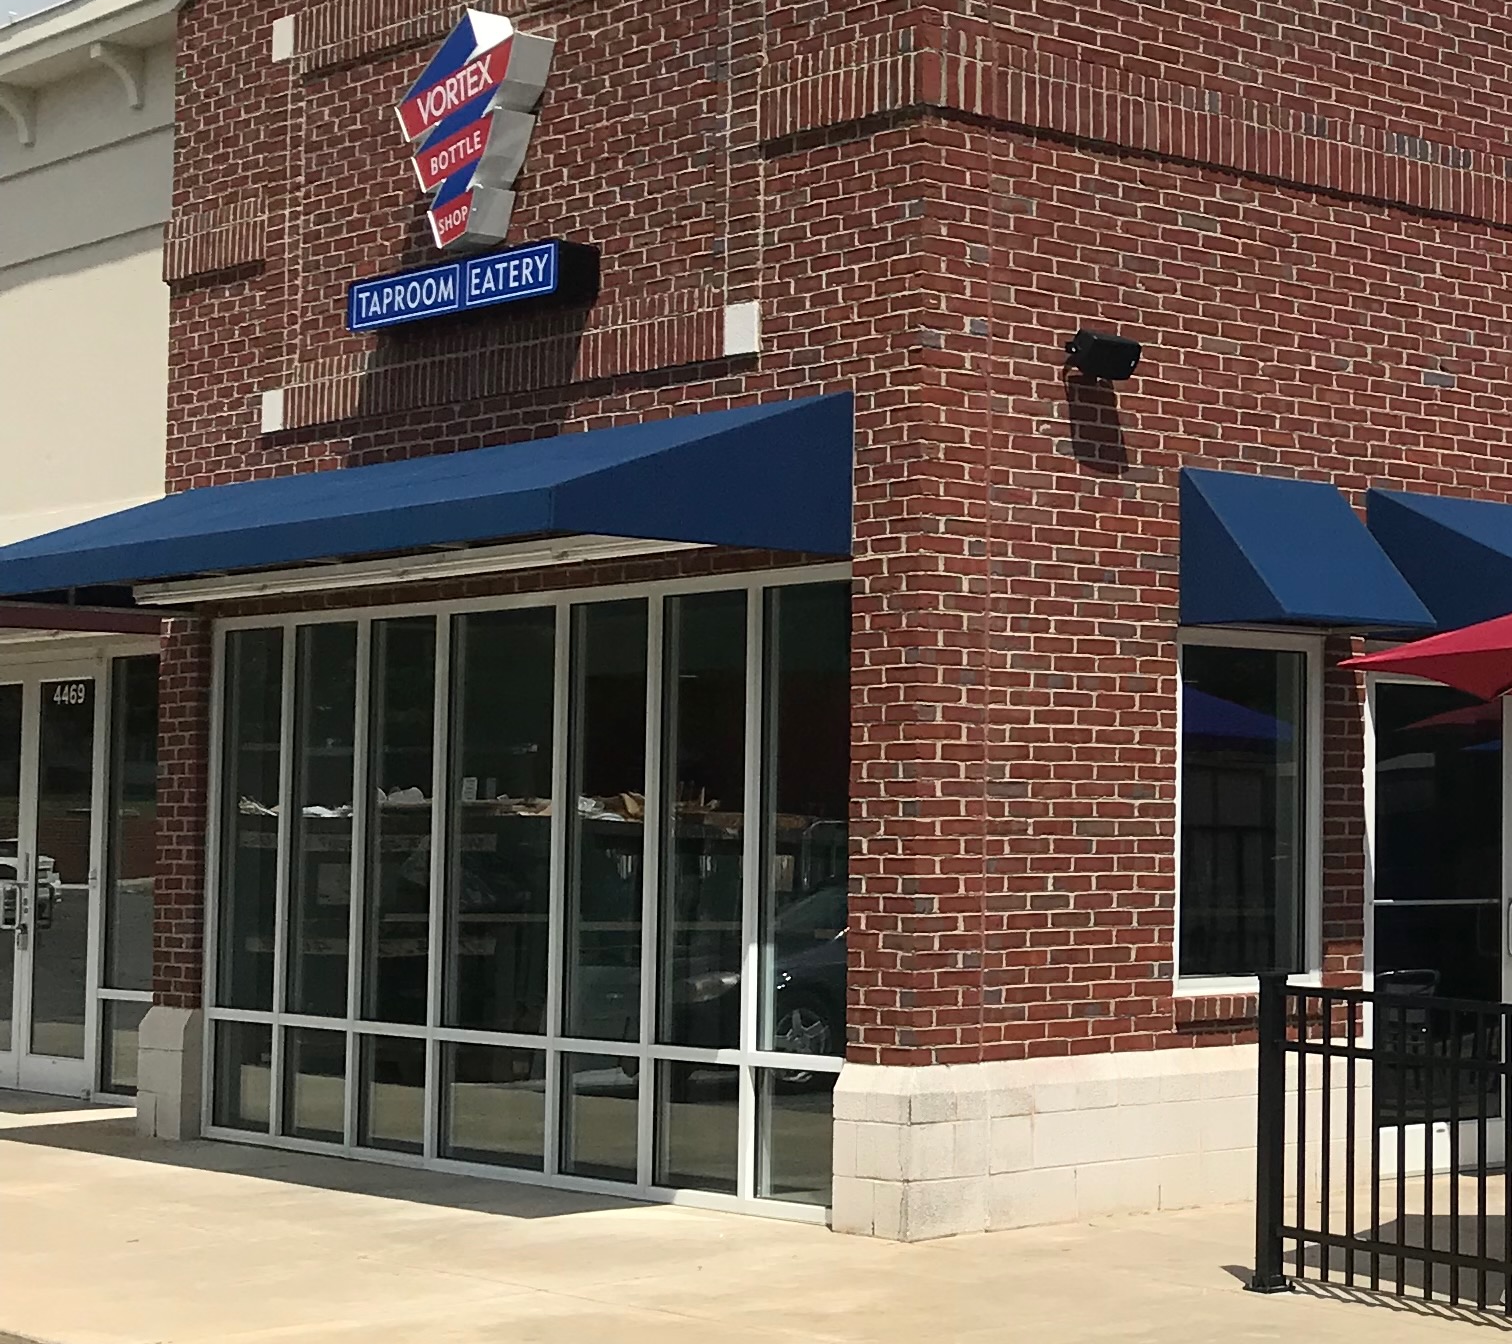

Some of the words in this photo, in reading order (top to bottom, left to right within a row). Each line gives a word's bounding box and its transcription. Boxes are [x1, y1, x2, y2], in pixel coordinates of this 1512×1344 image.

[416, 54, 494, 124] VORTEX
[430, 130, 482, 175] BOTTLE
[438, 205, 469, 234] SHOP
[358, 274, 454, 318] TAPROOM
[470, 253, 549, 296] EATERY
[53, 683, 85, 705] 4469
